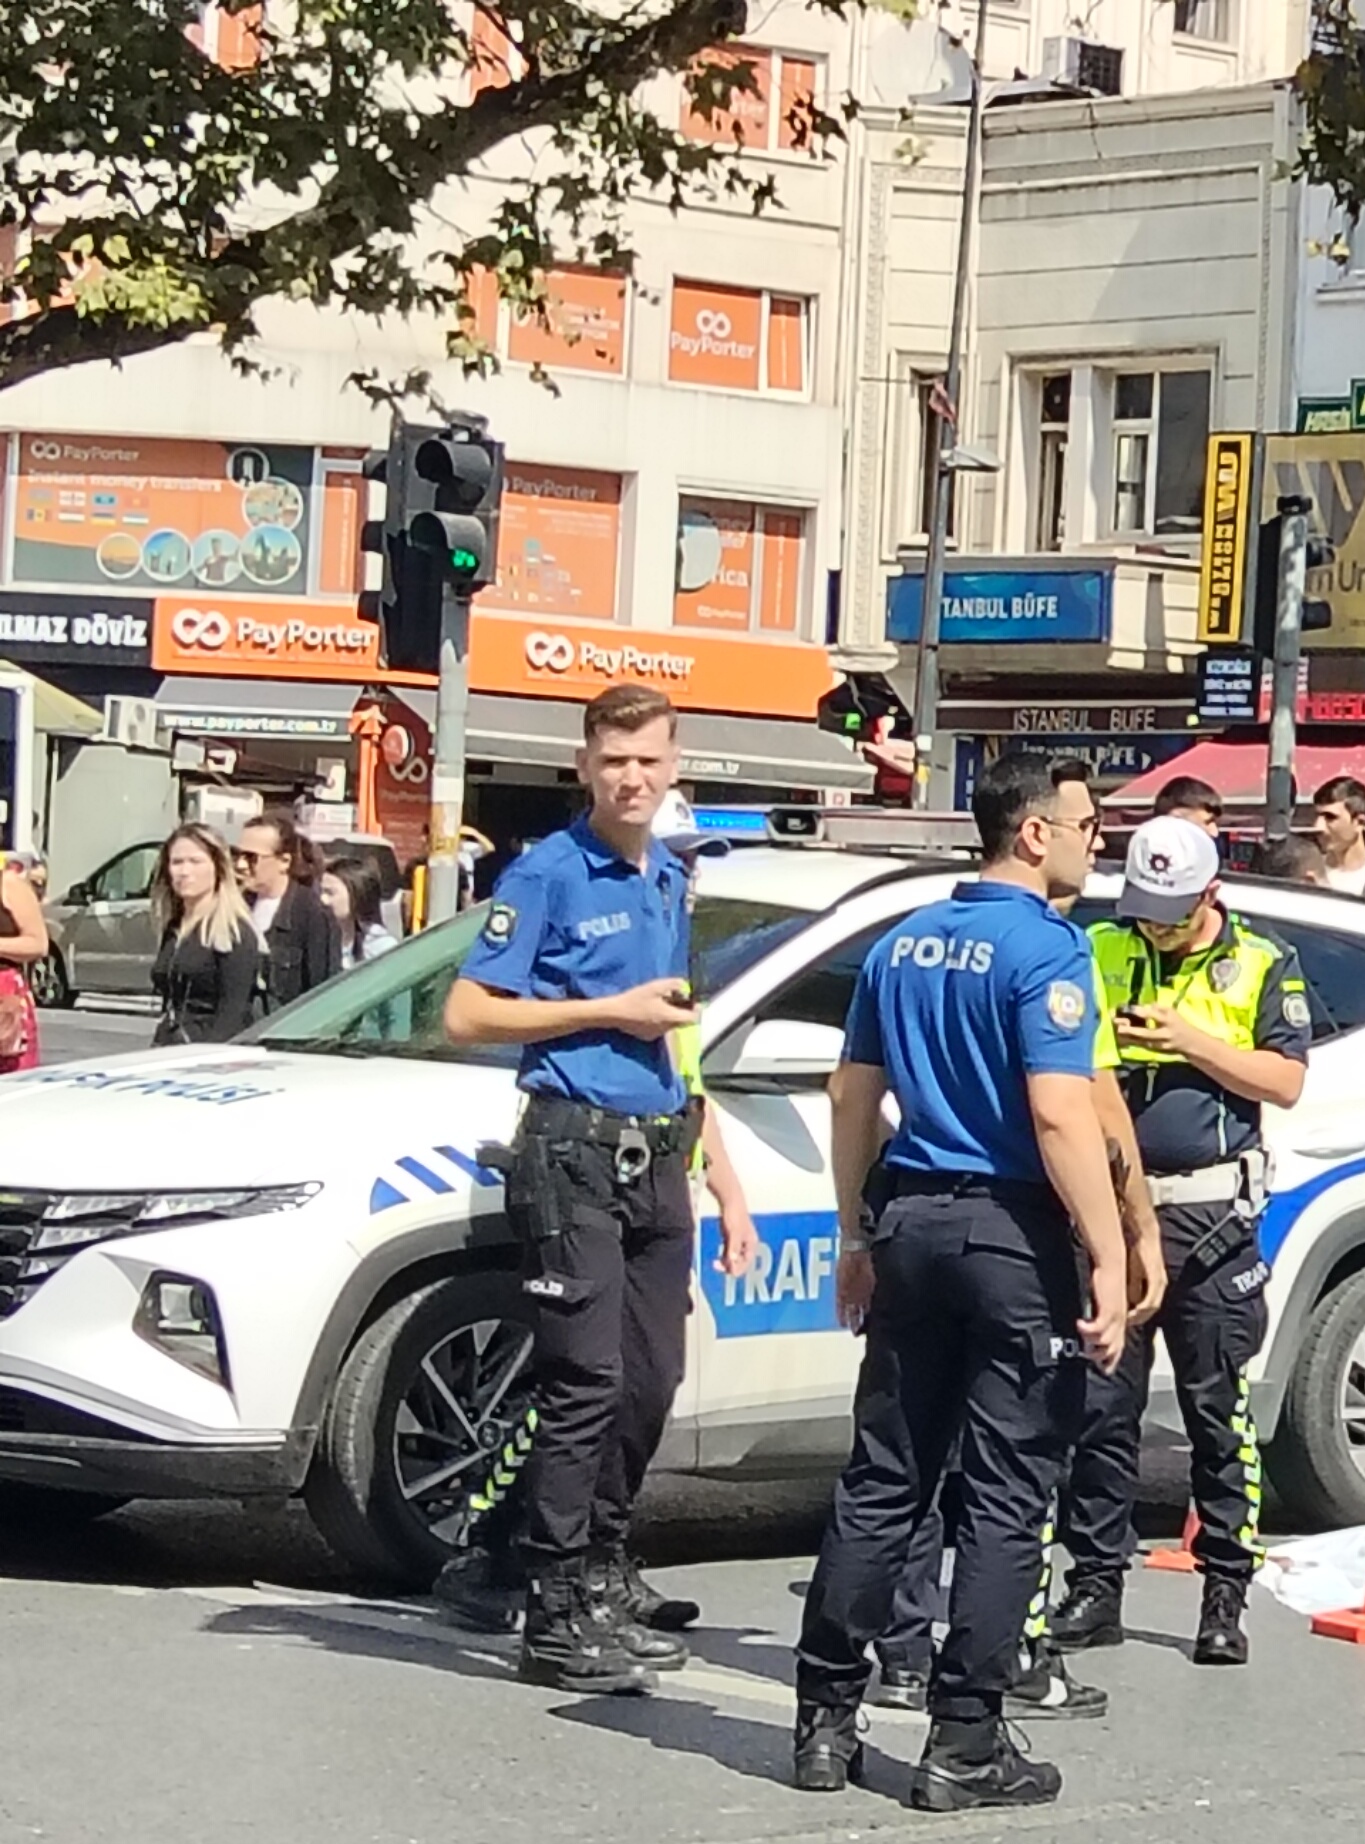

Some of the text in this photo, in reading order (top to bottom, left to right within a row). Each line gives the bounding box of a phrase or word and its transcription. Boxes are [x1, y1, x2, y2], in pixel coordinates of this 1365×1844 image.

[671, 330, 756, 359] PayPorter
[63, 444, 139, 462] PayPorter
[511, 476, 598, 501] PayPorter
[941, 592, 1058, 620] TANBUL BÜFE
[72, 612, 148, 647] DÖVİZ
[237, 617, 376, 652] PayPorter
[578, 641, 696, 677] PayPorter
[163, 713, 338, 733] www.payporter.com.tr
[722, 1236, 838, 1307] TRAF
